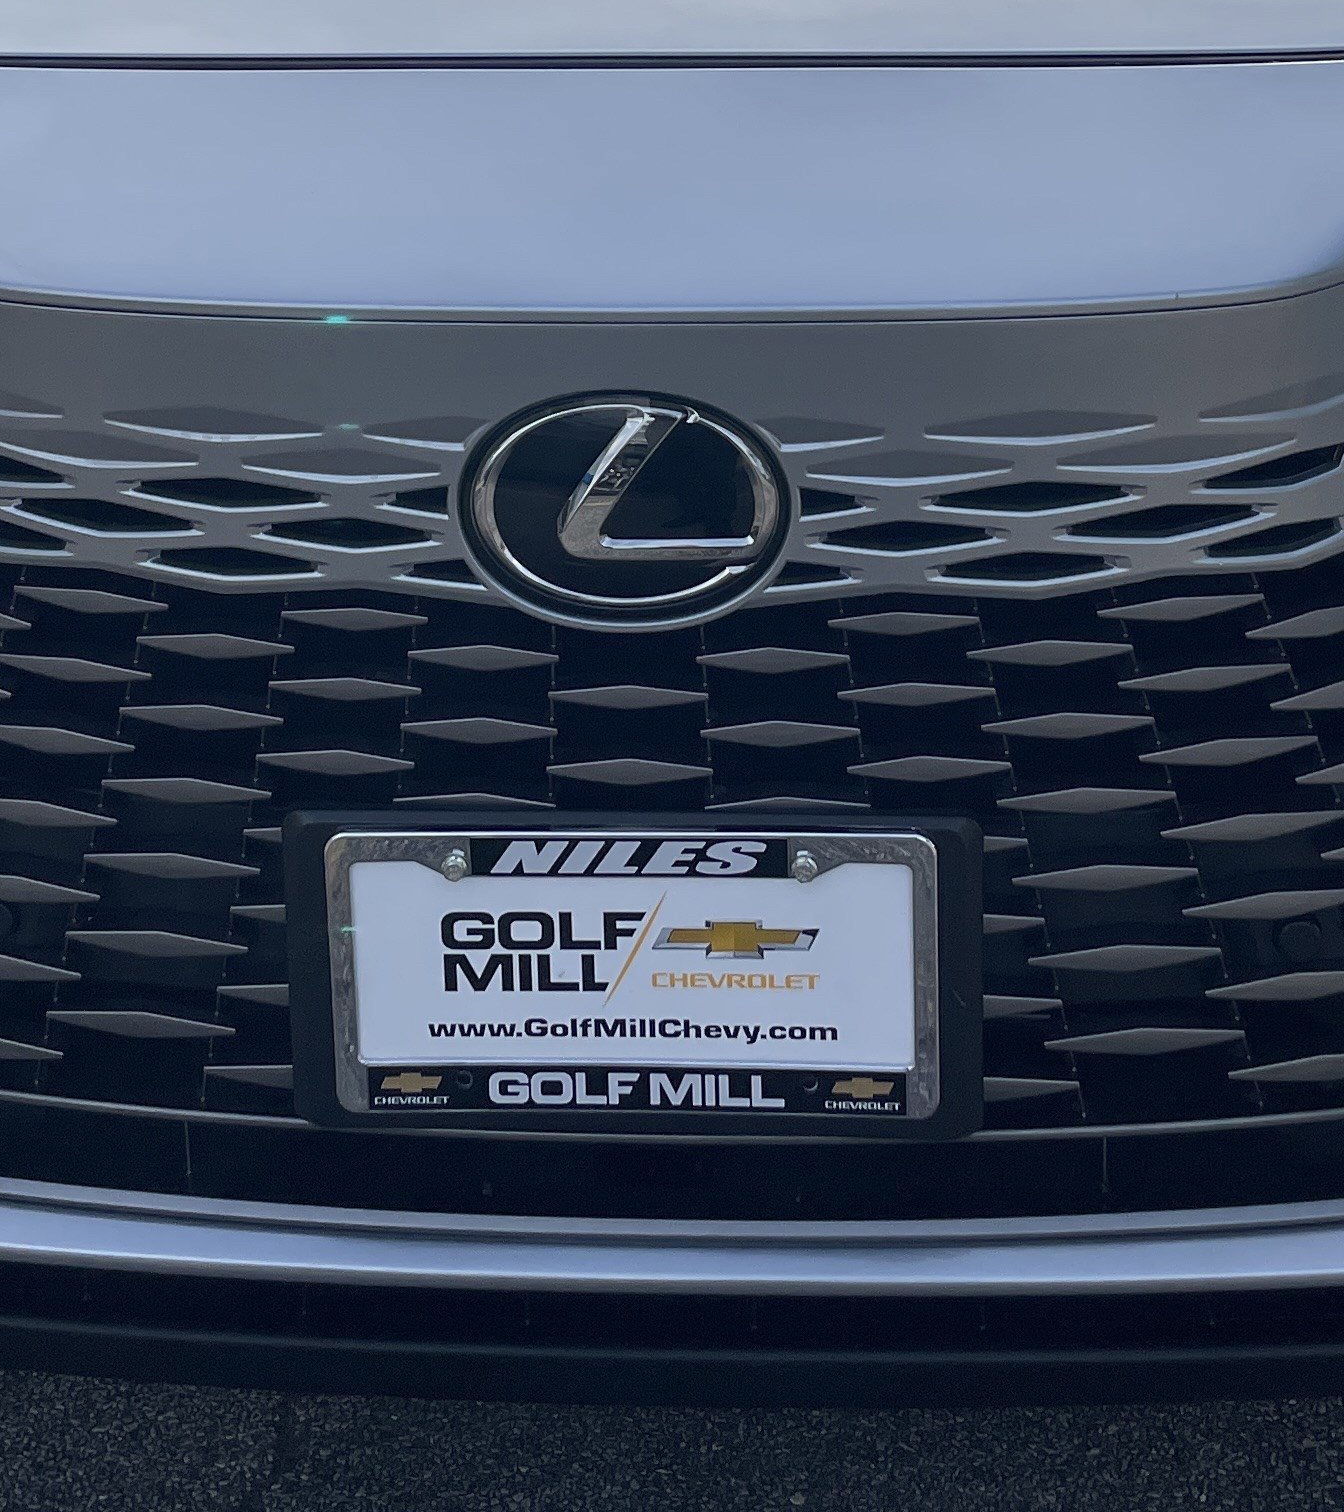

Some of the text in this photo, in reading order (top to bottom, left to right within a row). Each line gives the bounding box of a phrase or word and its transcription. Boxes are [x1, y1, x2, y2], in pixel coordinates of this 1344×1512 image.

[489, 840, 767, 875] NILES
[440, 911, 647, 950] GOLF
[443, 953, 609, 992] MILL
[651, 971, 820, 990] CHEVROLET
[427, 1017, 839, 1045] www.GolfMillChevy.com
[374, 1096, 450, 1106] CHEVROLET
[488, 1071, 785, 1108] GOLF MILL
[825, 1100, 901, 1111] CHEVROLET
